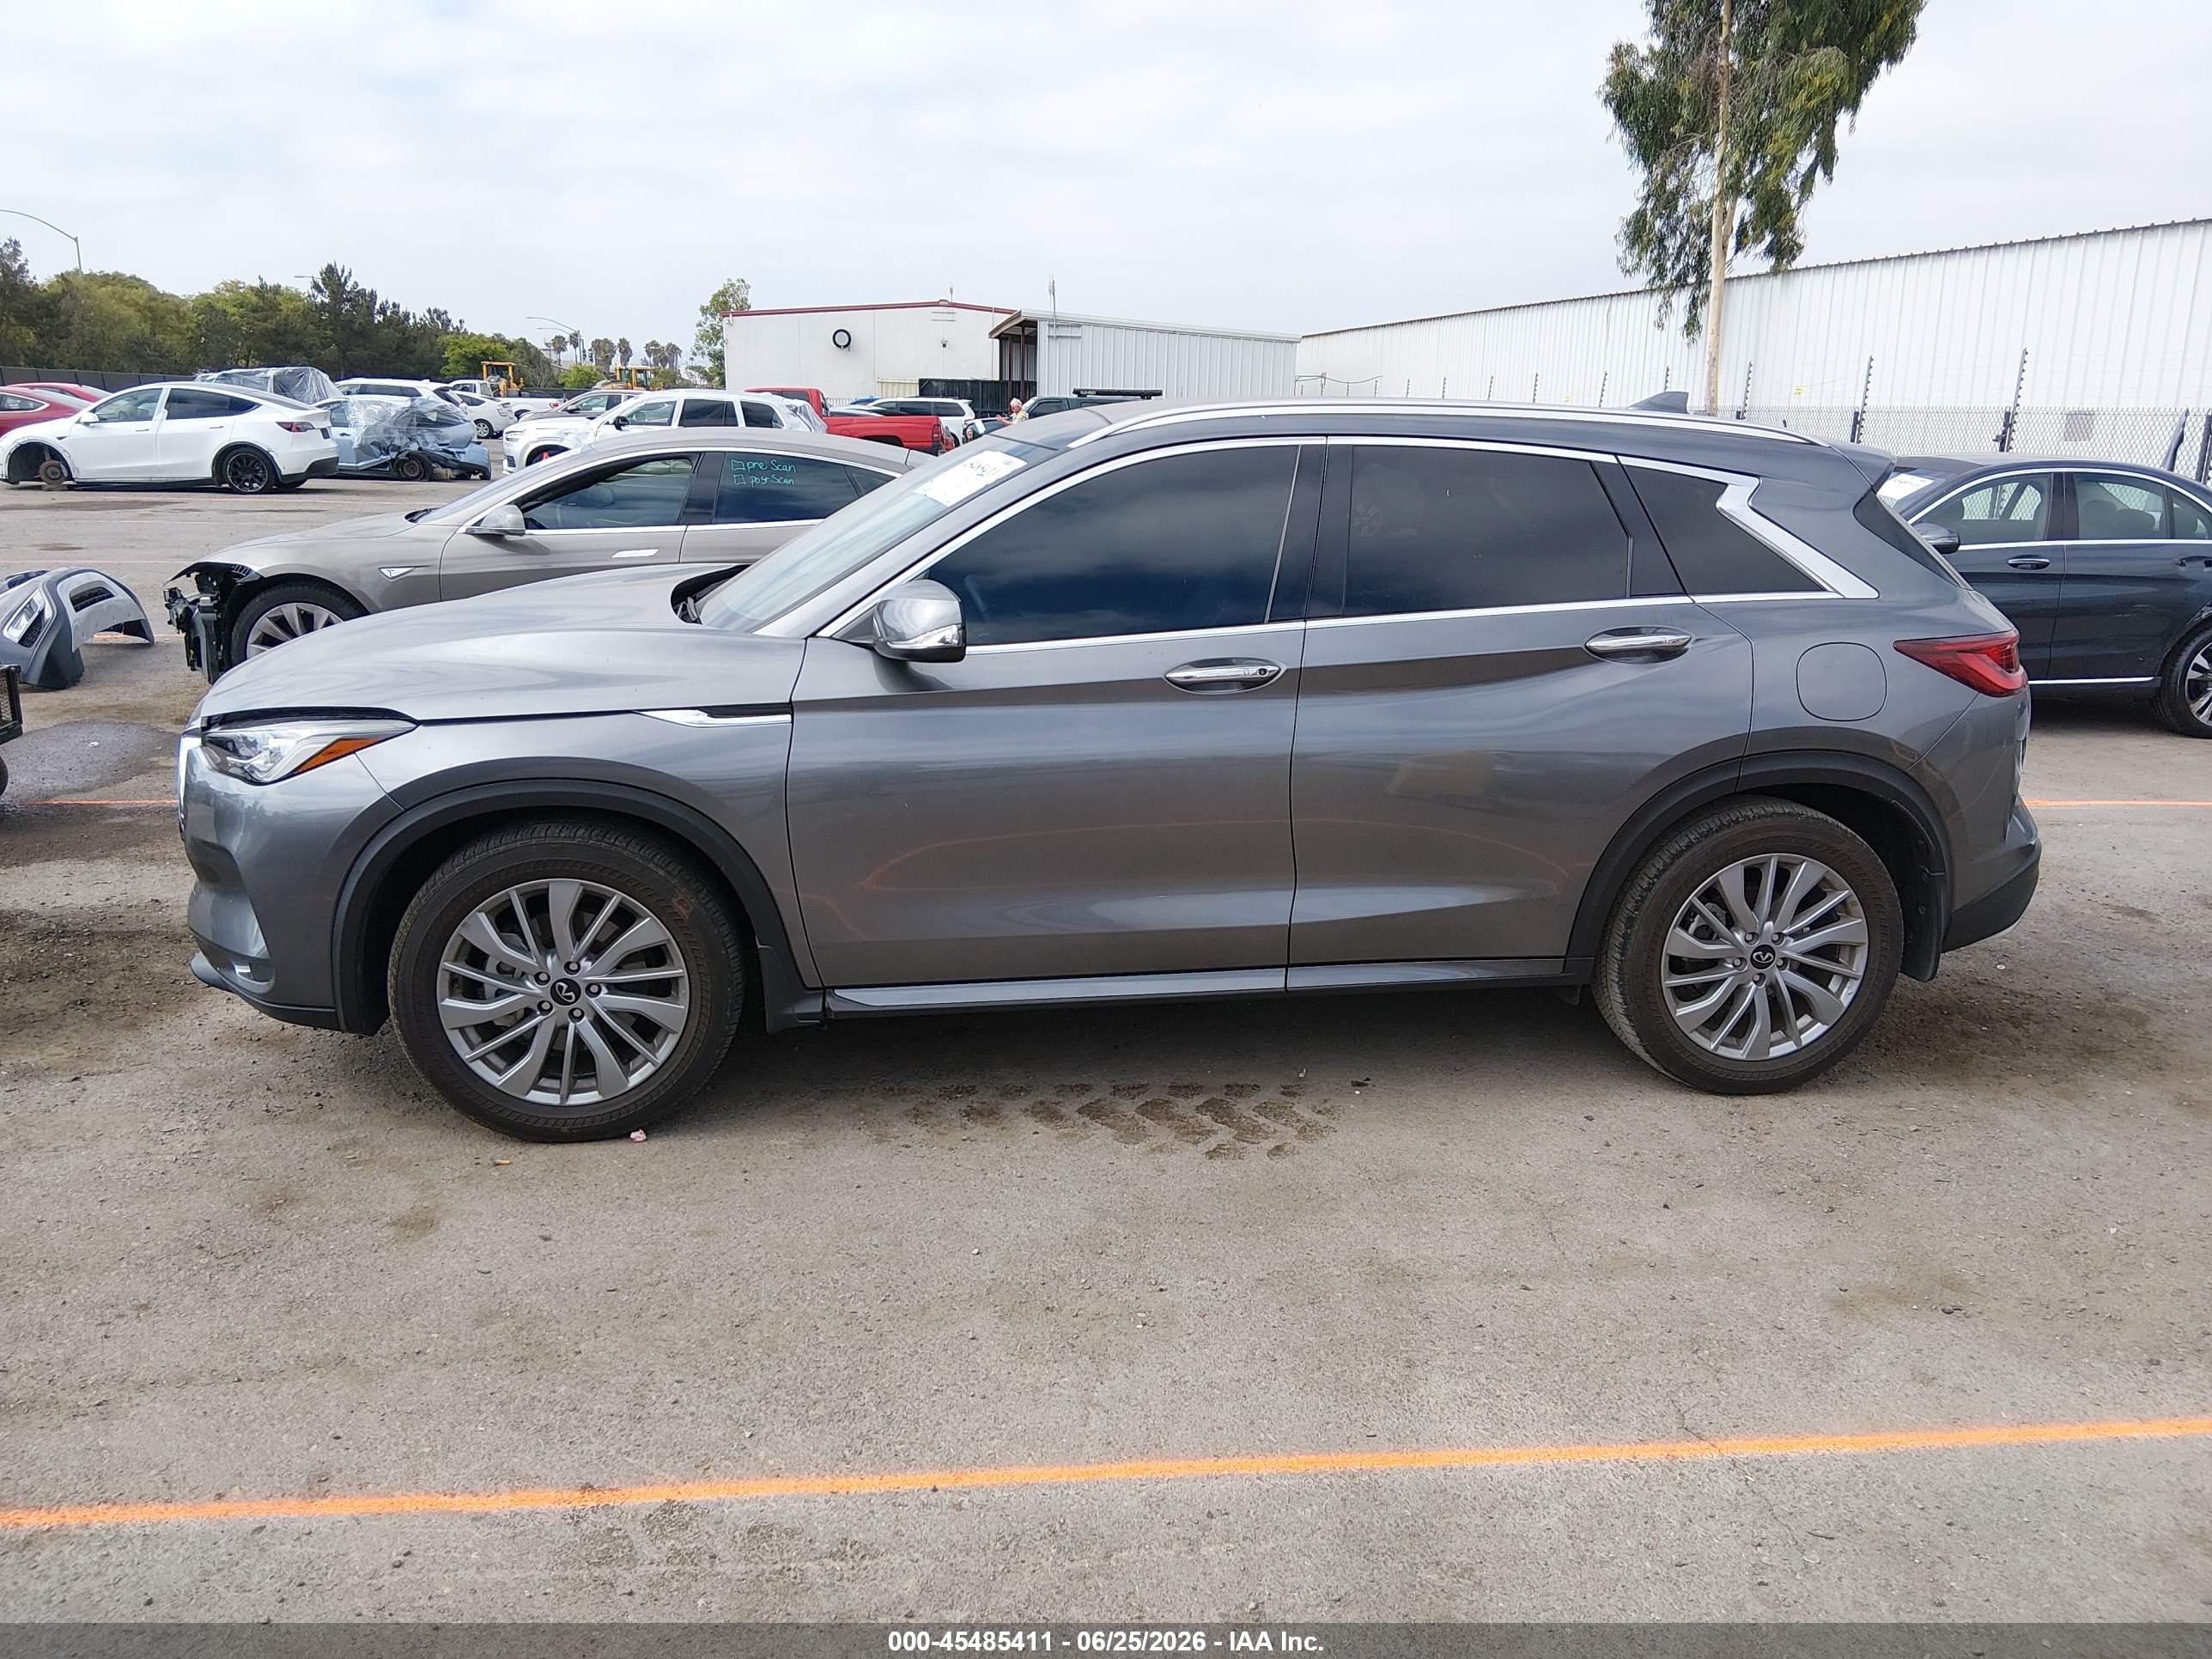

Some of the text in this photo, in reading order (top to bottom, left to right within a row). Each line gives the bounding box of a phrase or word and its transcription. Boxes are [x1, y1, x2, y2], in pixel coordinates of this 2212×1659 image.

[770, 459, 797, 474] Scan
[749, 474, 794, 488] post Scan
